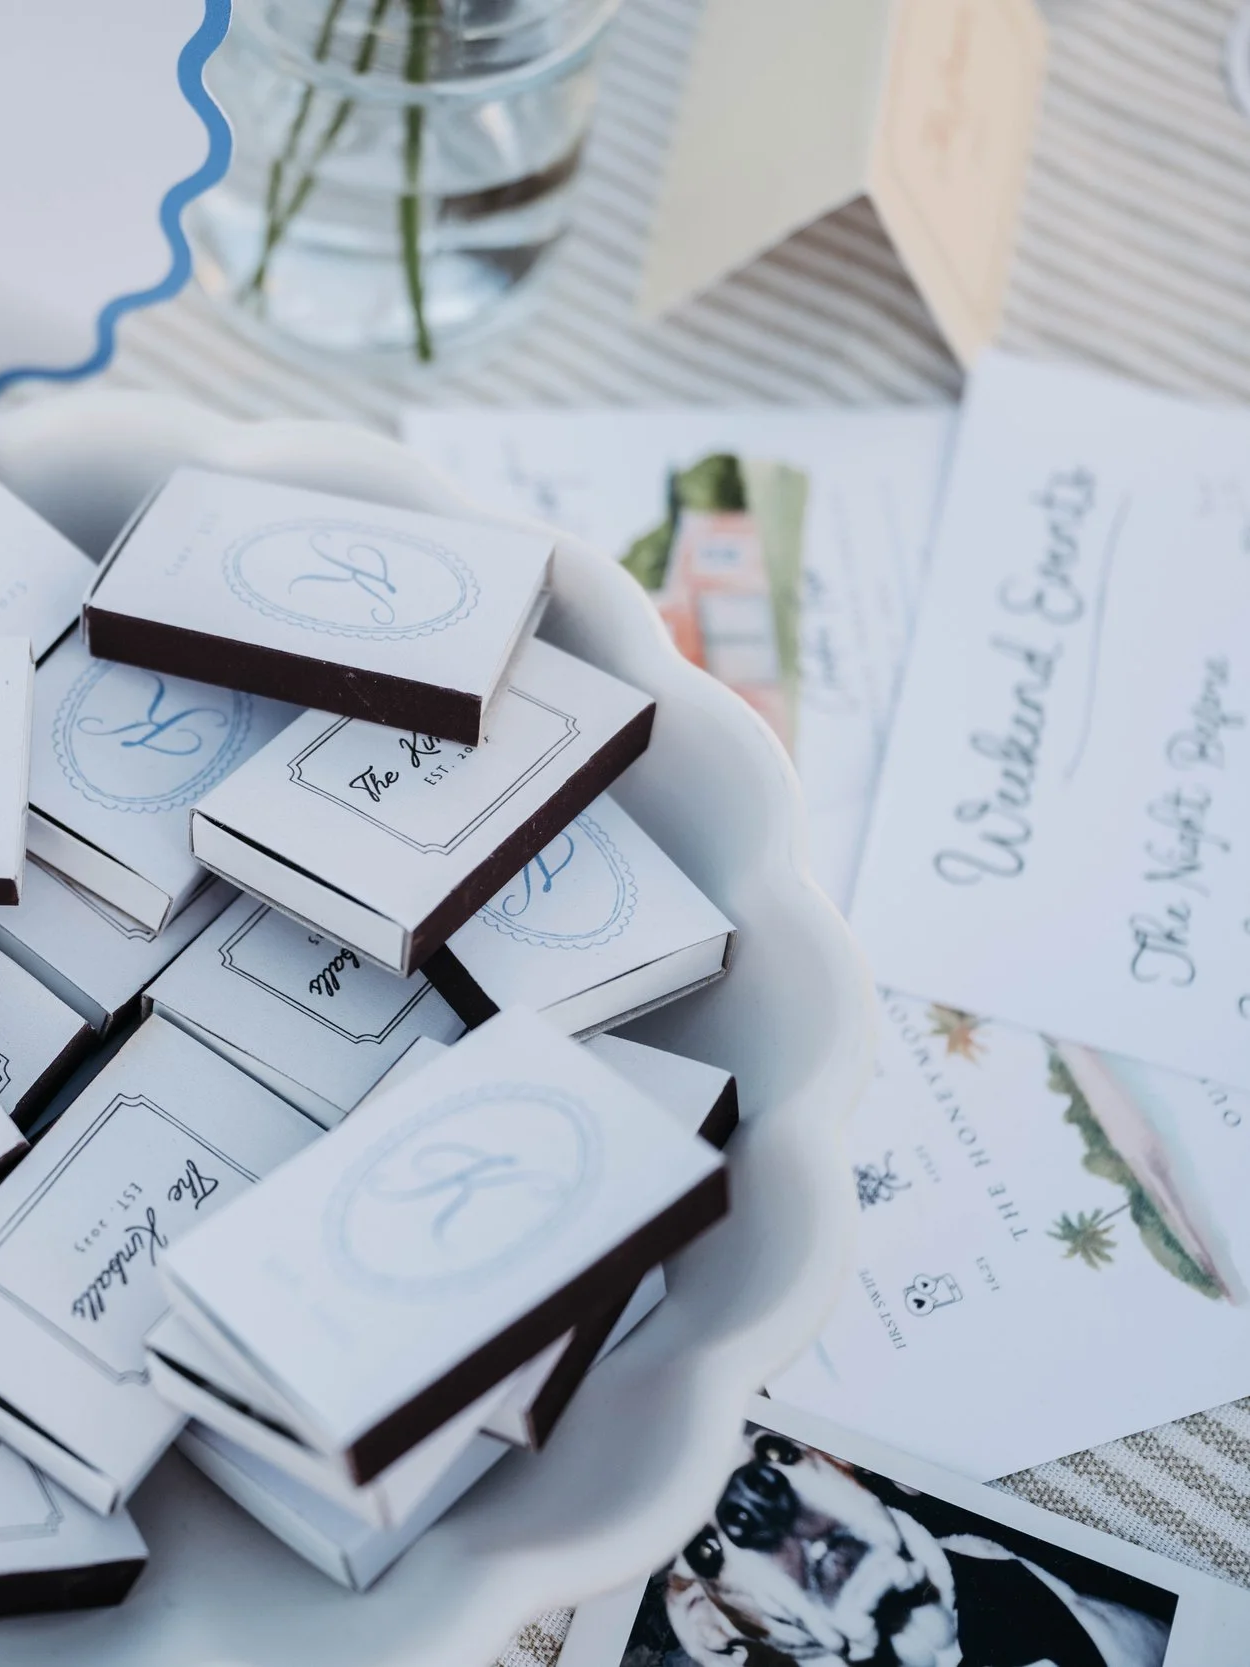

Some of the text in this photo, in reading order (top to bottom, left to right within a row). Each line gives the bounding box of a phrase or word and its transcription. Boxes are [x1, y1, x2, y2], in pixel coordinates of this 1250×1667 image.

[349, 765, 400, 802] The
[1129, 899, 1197, 988] The
[71, 1159, 219, 1322] The Kimballs
[987, 1181, 1029, 1242] THE
[879, 1312, 907, 1350] FIRST
